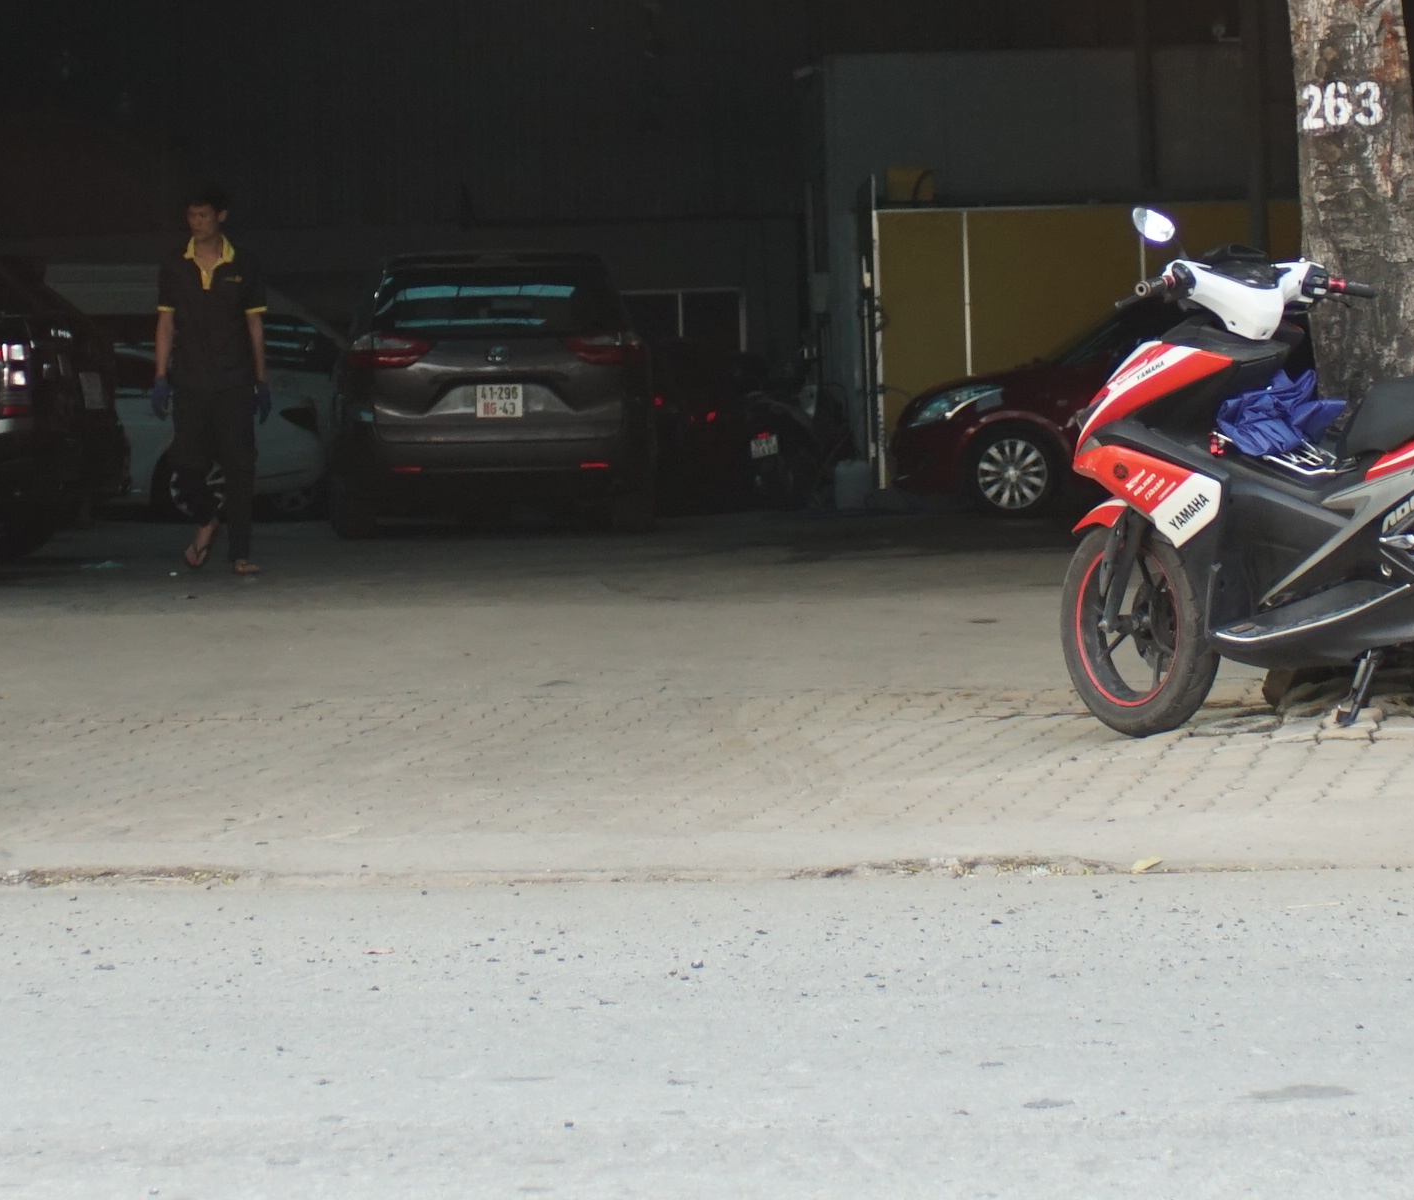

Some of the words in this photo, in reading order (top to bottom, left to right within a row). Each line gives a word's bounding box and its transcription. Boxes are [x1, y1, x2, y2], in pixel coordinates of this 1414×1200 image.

[1302, 81, 1384, 129] 263
[1137, 360, 1165, 381] YAMAHA
[481, 385, 518, 400] 41-296
[1169, 493, 1210, 531] YAMAHA
